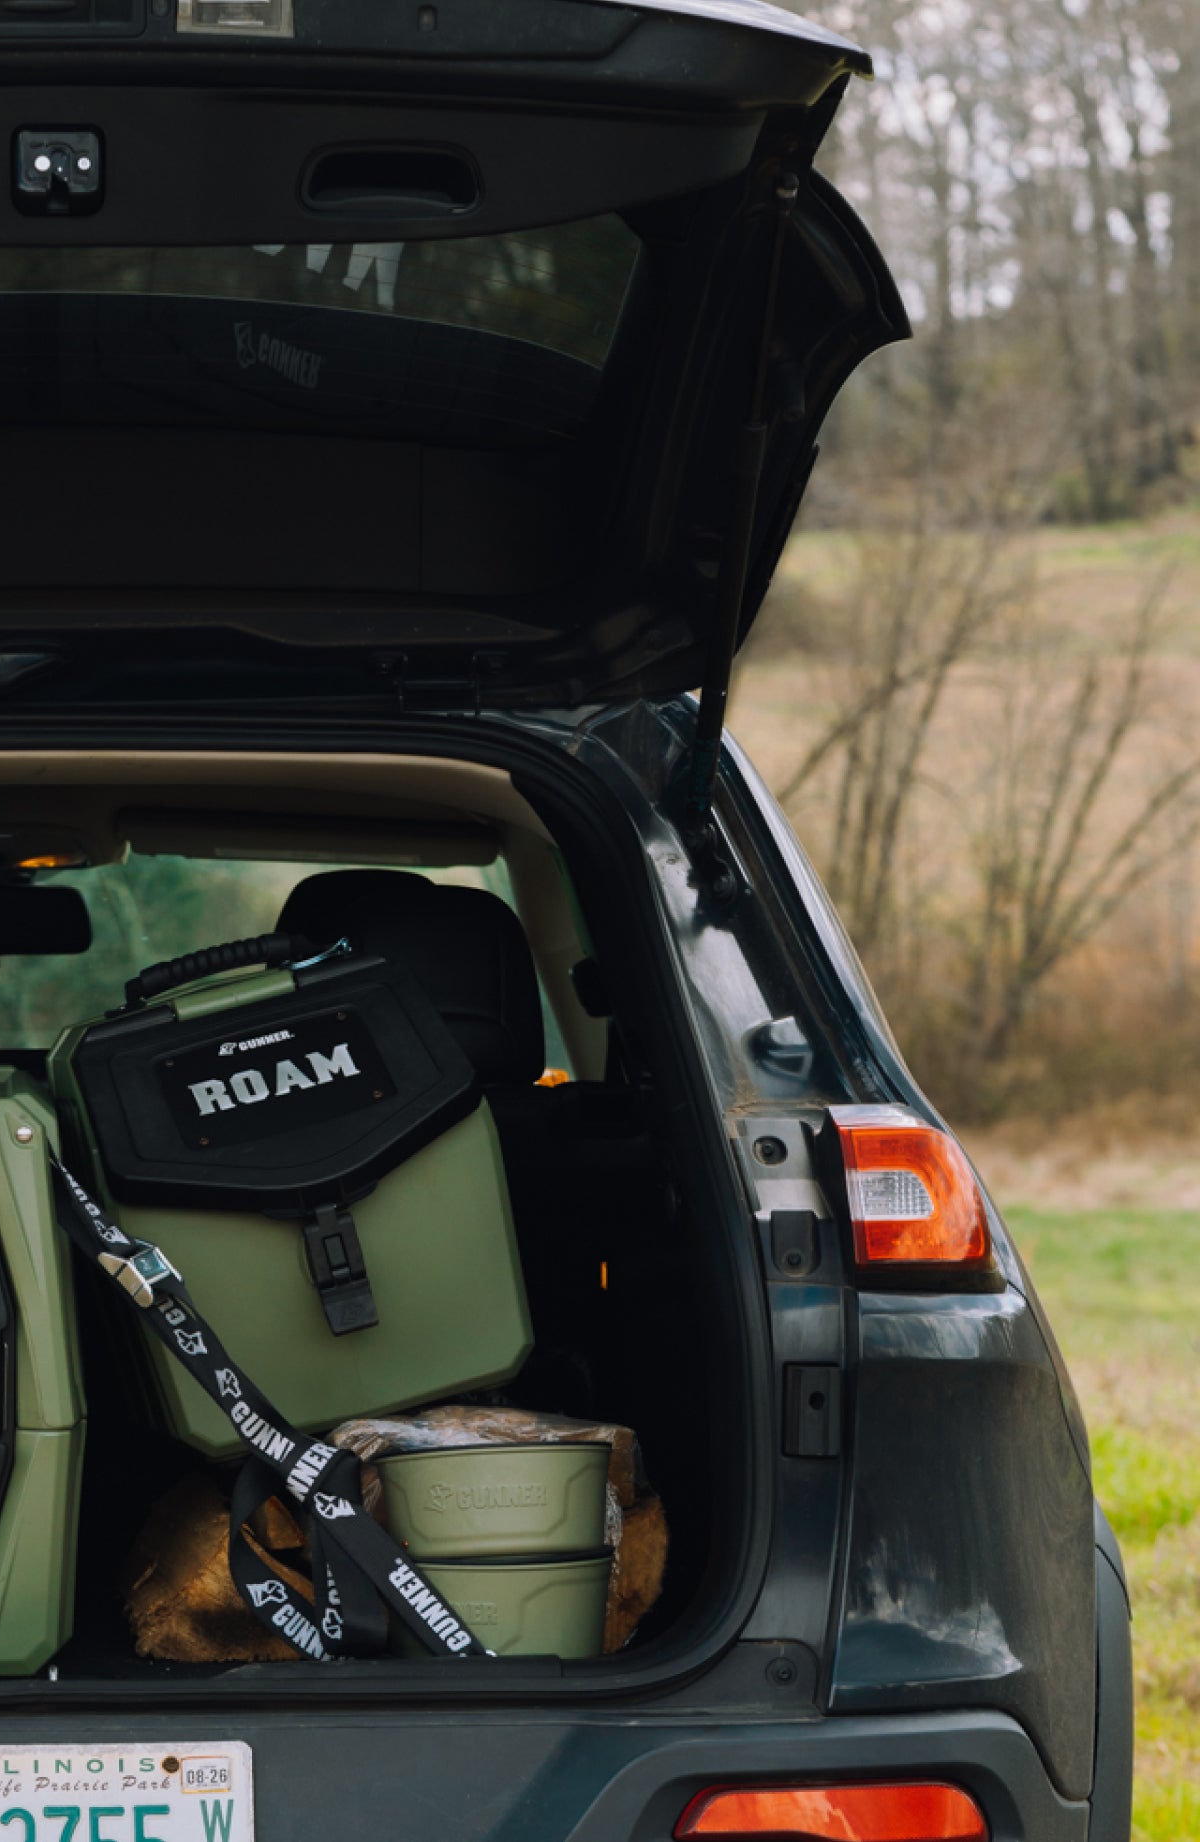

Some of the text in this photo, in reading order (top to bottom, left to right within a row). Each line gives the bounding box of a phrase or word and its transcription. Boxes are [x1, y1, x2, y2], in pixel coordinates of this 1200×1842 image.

[187, 1043, 361, 1116] ROAM
[456, 1483, 549, 1510] GUNNER
[33, 1776, 110, 1792] Prairie
[120, 1774, 172, 1791] Park
[186, 1768, 228, 1785] 08-26
